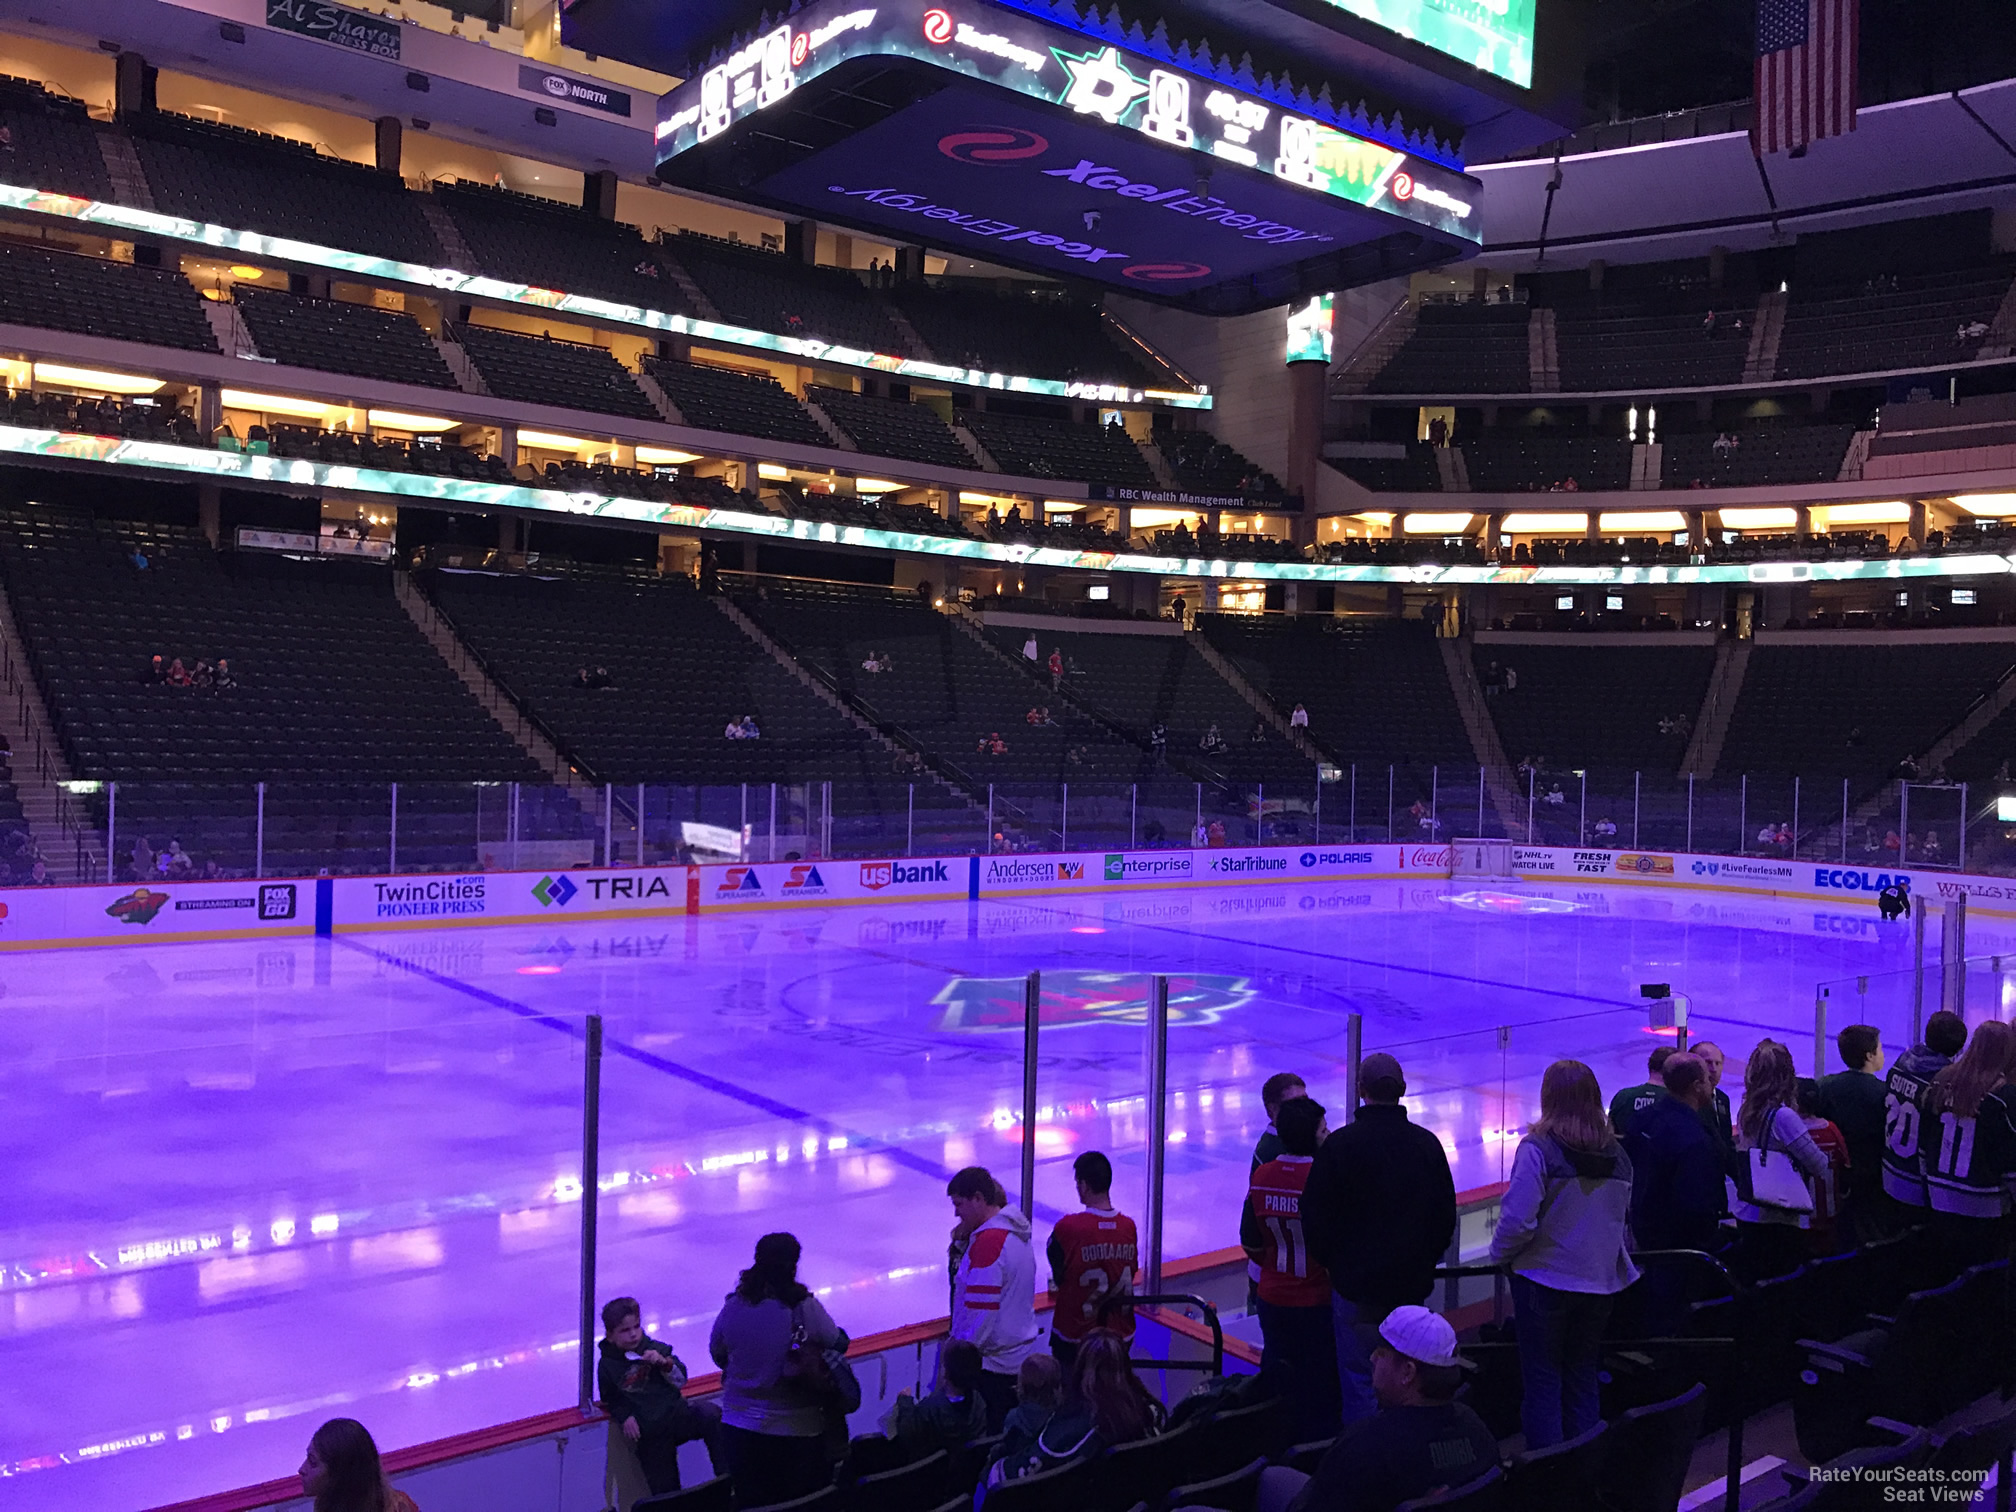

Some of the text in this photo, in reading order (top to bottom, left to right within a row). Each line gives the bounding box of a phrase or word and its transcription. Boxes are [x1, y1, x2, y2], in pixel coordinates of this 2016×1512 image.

[267, 0, 400, 47] Al Shaver
[328, 31, 399, 58] PRESS BOX
[549, 79, 608, 104] FOX NORTH
[1119, 488, 1139, 500] RBC
[1142, 490, 1177, 502] Wealth
[1179, 493, 1244, 507] Management
[1110, 857, 1191, 875] enterprise
[1319, 852, 1373, 864] POLARIS
[1512, 860, 1555, 870] WATCH LIVE
[1573, 852, 1612, 861] FRESH
[987, 859, 1054, 878] Andersen
[1577, 864, 1607, 873] FAST
[264, 887, 291, 900] FOX
[374, 881, 485, 902] TwinCities
[586, 876, 670, 900] TRIA
[180, 899, 252, 909] STREAMING ON
[264, 904, 290, 917] GO
[377, 899, 485, 917] PIONEER PRESS
[1889, 1074, 1918, 1100] SUTER
[1885, 1093, 1920, 1159] 20
[1937, 1111, 1977, 1178] 11
[1081, 1242, 1136, 1262] BOOGAARD
[1265, 1217, 1307, 1278] 11
[1079, 1266, 1133, 1318] 24
